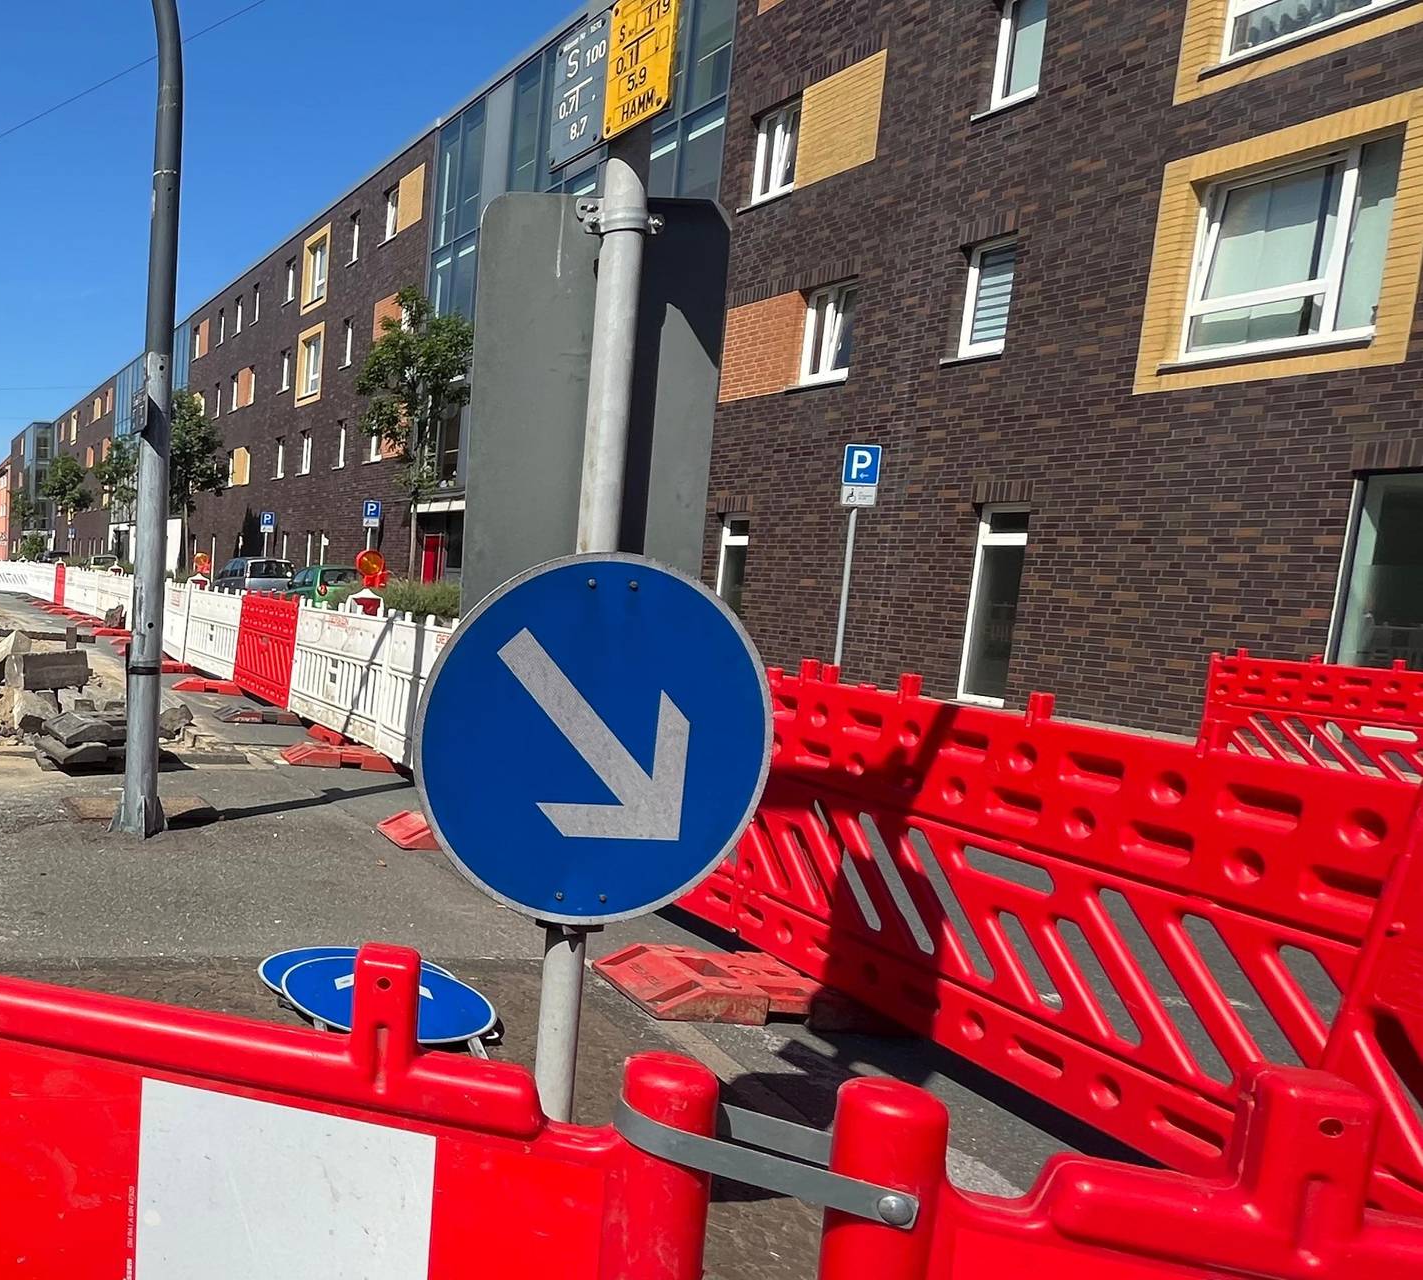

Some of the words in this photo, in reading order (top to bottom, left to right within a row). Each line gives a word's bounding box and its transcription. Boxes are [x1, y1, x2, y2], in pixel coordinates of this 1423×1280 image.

[566, 48, 580, 78] S
[585, 39, 607, 67] 100
[621, 88, 655, 122] HAMM
[851, 450, 872, 479] P
[263, 513, 272, 524] P
[367, 503, 377, 515] P
